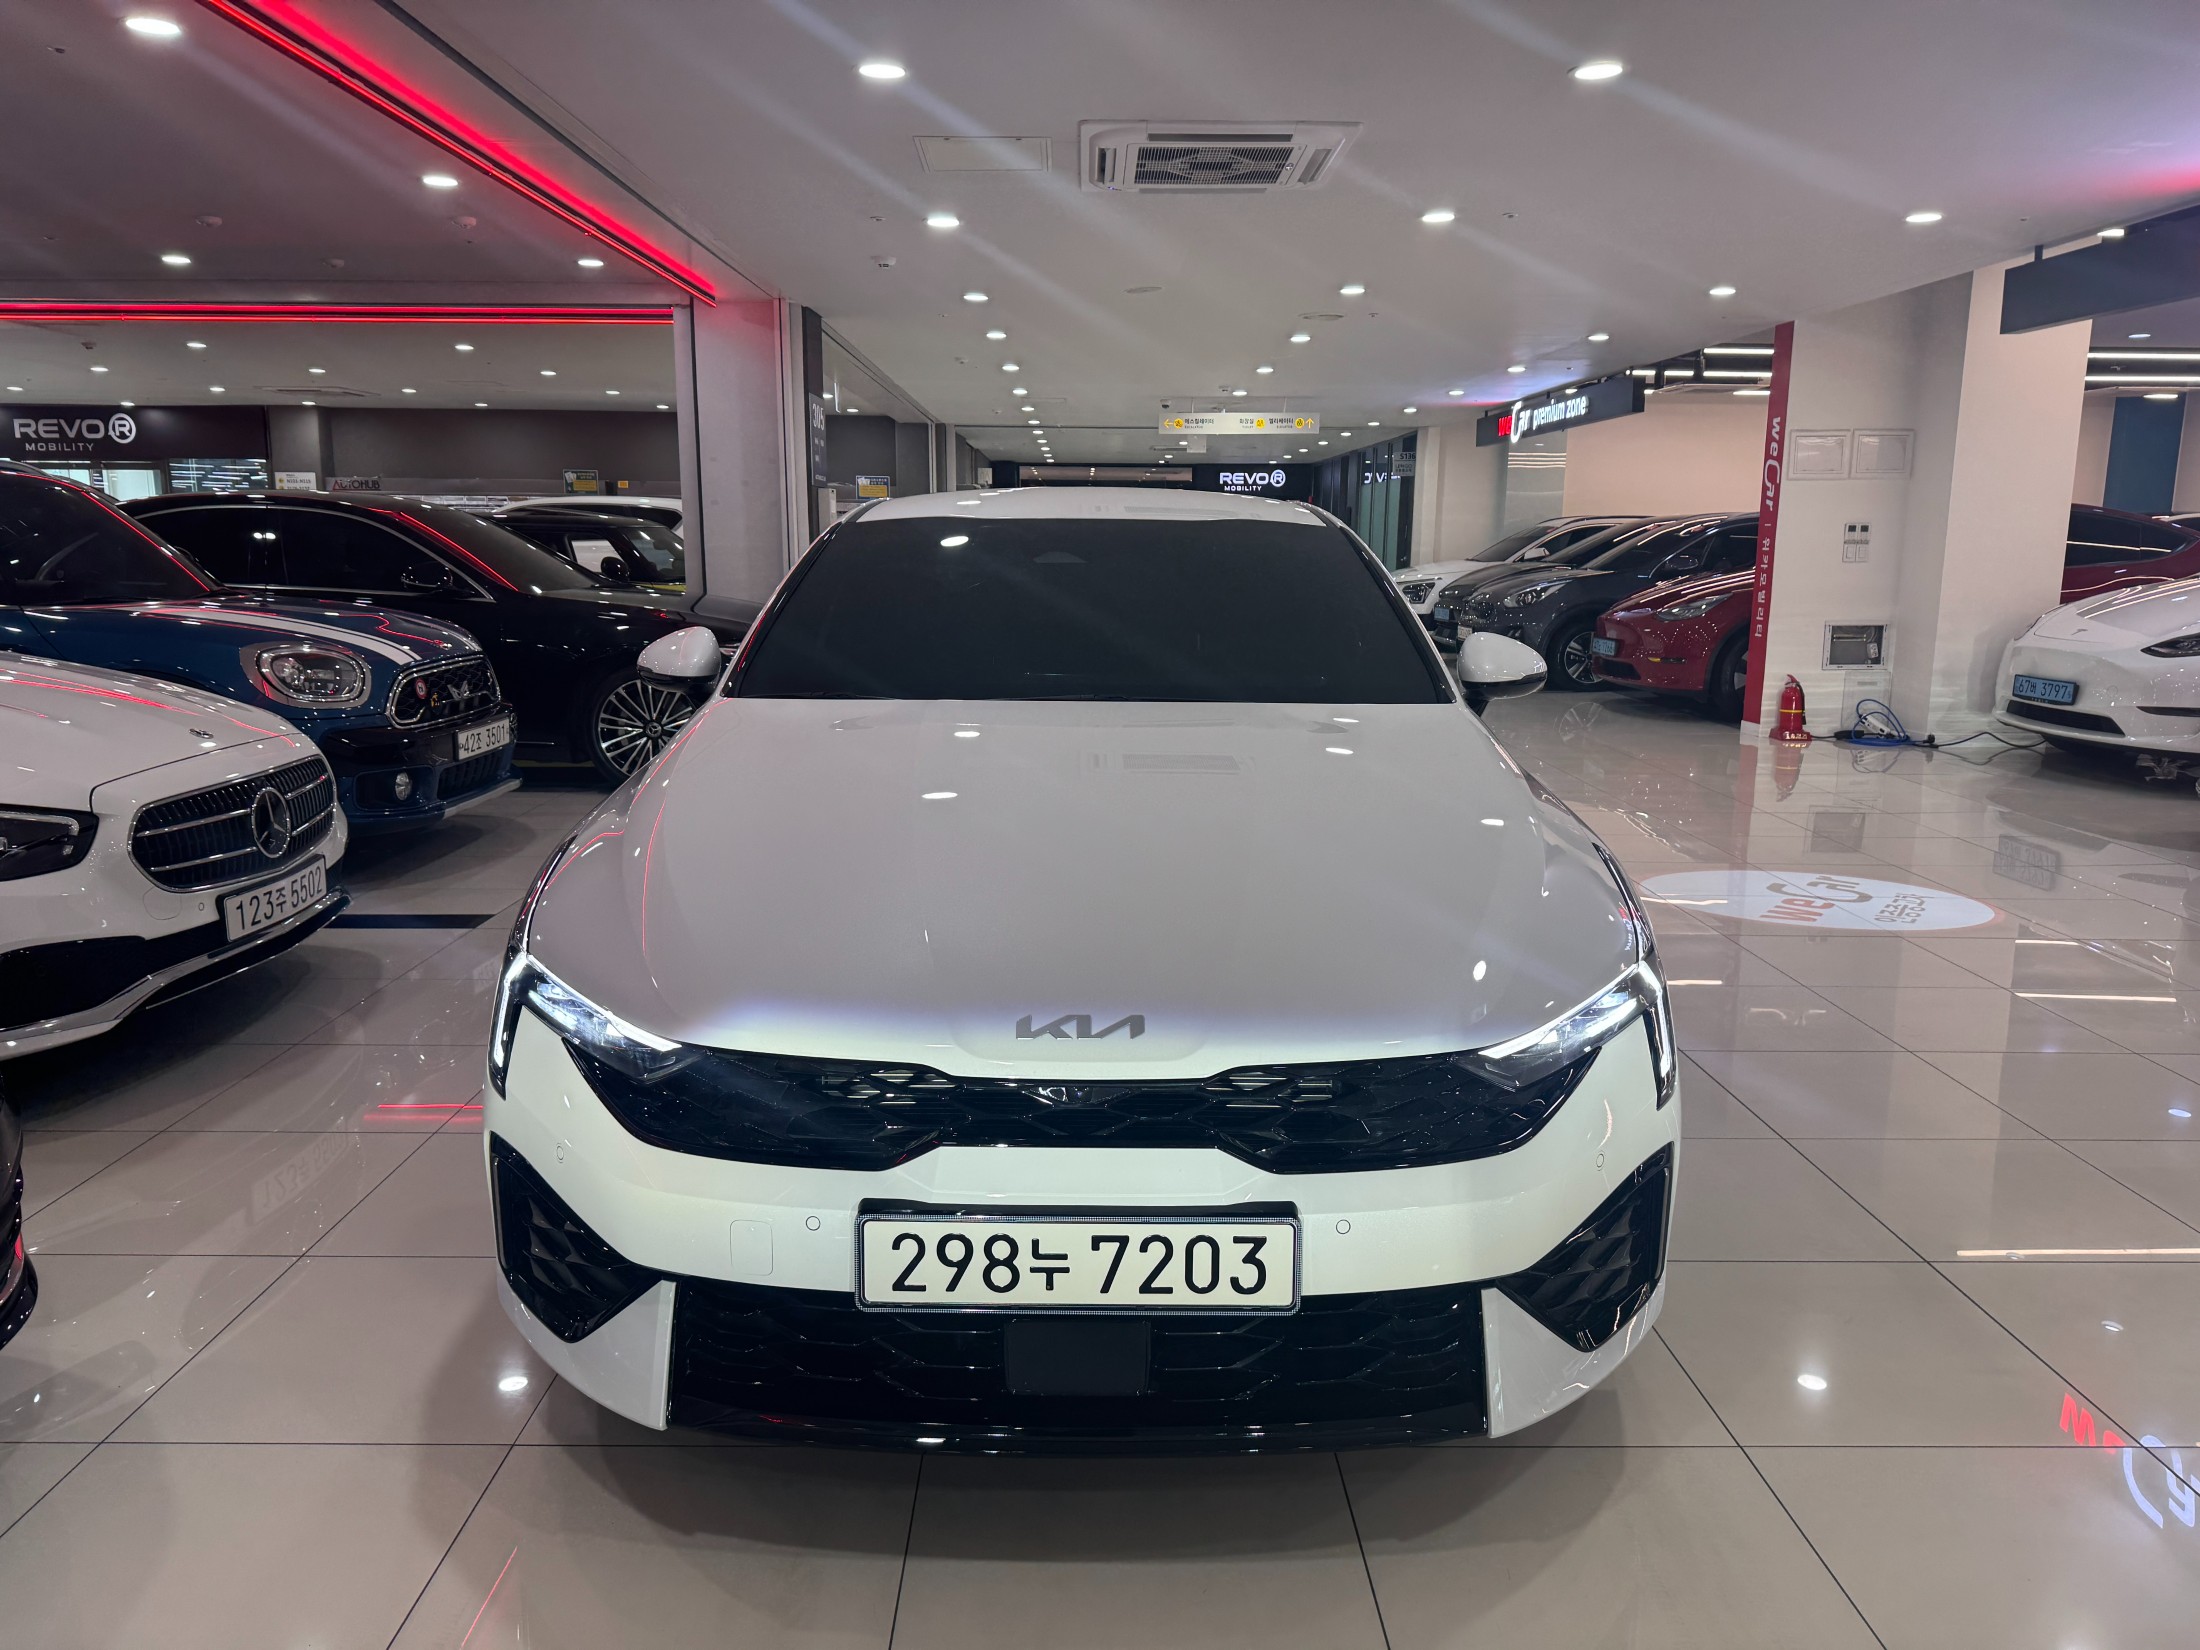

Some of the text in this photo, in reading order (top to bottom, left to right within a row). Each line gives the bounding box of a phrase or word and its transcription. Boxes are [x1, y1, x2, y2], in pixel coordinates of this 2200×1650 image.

[812, 403, 825, 431] 305
[1497, 395, 1589, 443] weCar premium zone
[25, 442, 94, 451] MOBILITY
[1764, 416, 1781, 512] weCar
[332, 479, 381, 491] AUTOHUB
[2040, 681, 2068, 700] 3797
[463, 723, 505, 754] 42조 3501
[236, 865, 323, 931] 123주 5502
[1758, 875, 1875, 923] weCar
[1015, 1014, 1146, 1040] KIA
[891, 1232, 1269, 1295] 298누 7203
